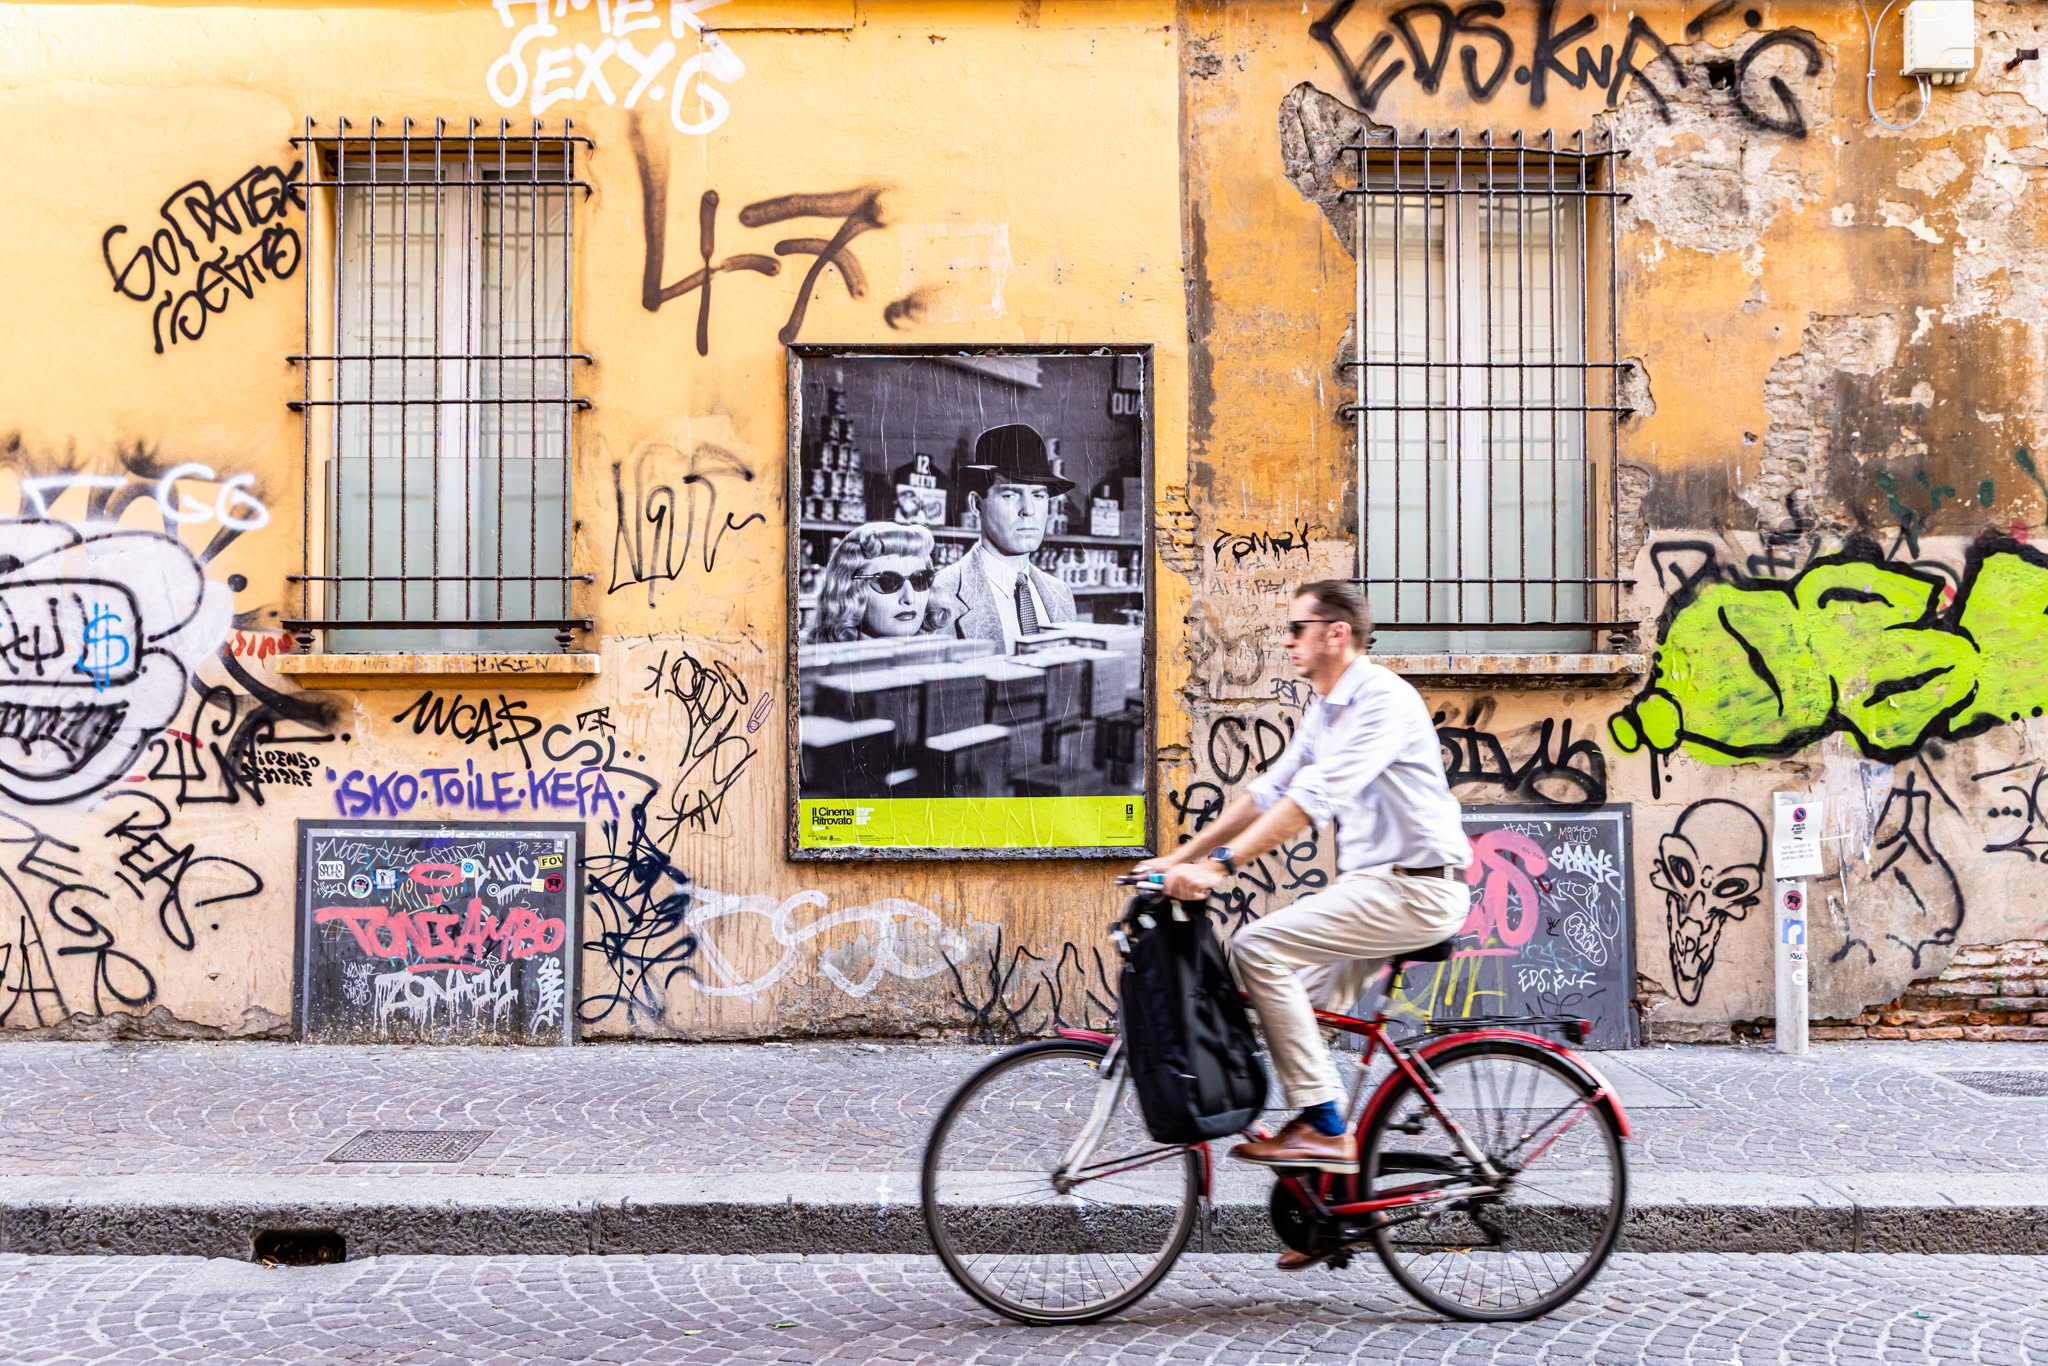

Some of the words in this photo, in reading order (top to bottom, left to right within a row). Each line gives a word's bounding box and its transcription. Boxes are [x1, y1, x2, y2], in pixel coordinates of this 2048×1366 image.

[812, 807, 817, 816] Il
[818, 807, 854, 816] Cinema
[812, 816, 852, 825] Ritrovato
